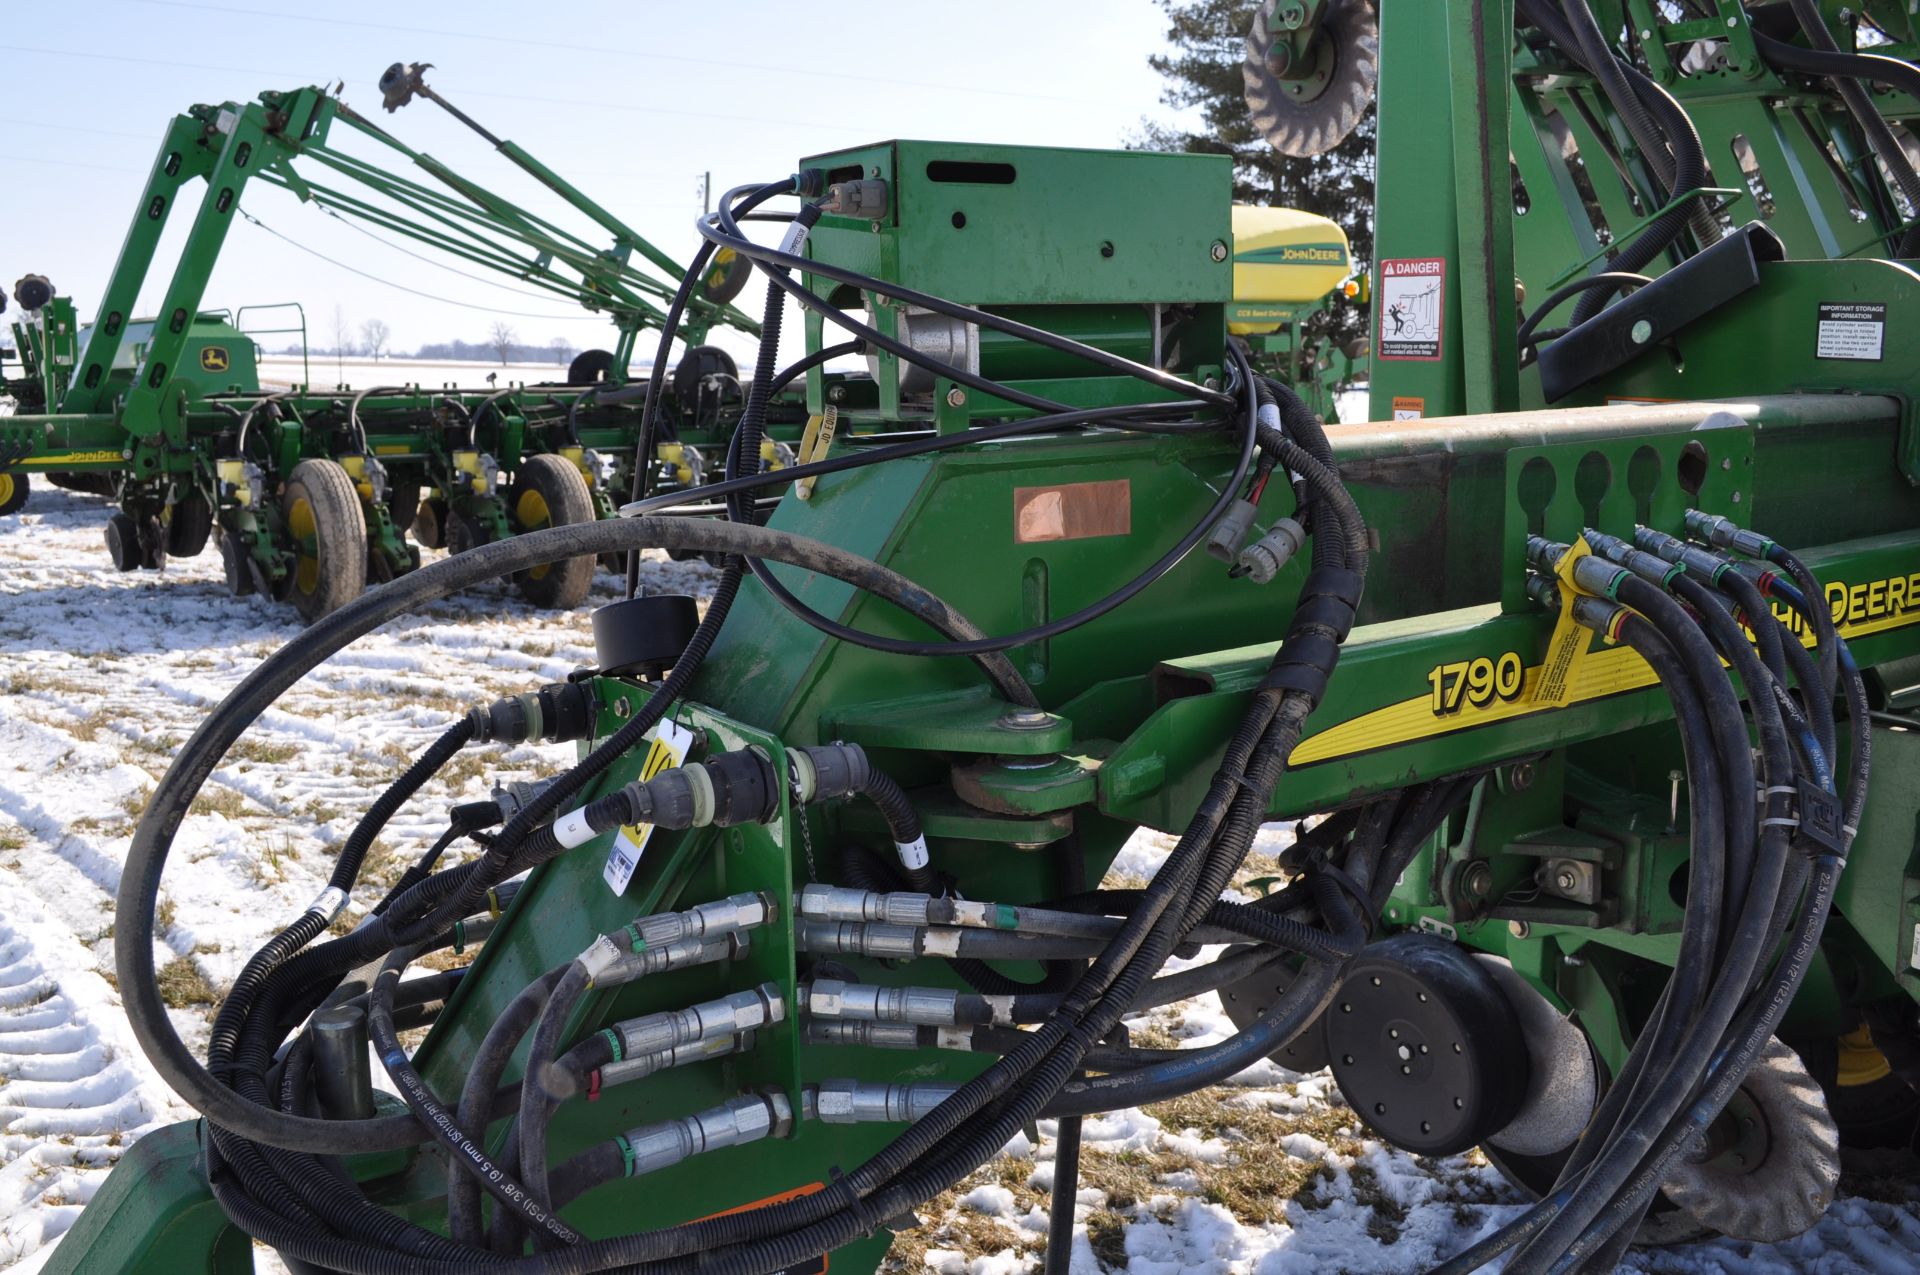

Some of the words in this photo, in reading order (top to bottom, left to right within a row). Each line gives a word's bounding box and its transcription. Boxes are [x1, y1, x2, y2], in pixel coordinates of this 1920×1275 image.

[1281, 248, 1308, 260] JOHN
[1308, 248, 1340, 261] DEERE
[1396, 262, 1440, 274] DANGER
[1268, 310, 1292, 318] Delivery
[821, 433, 831, 444] JD
[1825, 572, 1920, 627] DEERE
[1428, 651, 1523, 717] 1790
[1812, 892, 1826, 914] MPa
[1795, 939, 1812, 966] PSI)
[1773, 978, 1792, 1011] (12.5
[1763, 1002, 1782, 1026] mm)
[1092, 1074, 1143, 1088] megasys
[412, 1086, 425, 1104] SAE
[432, 1115, 463, 1144] ISO11237
[461, 1140, 485, 1165] mm)
[480, 1160, 504, 1185] (9.5
[499, 1182, 525, 1203] 3/8"
[523, 1198, 547, 1224] PSI)
[547, 1217, 580, 1246] (3250
